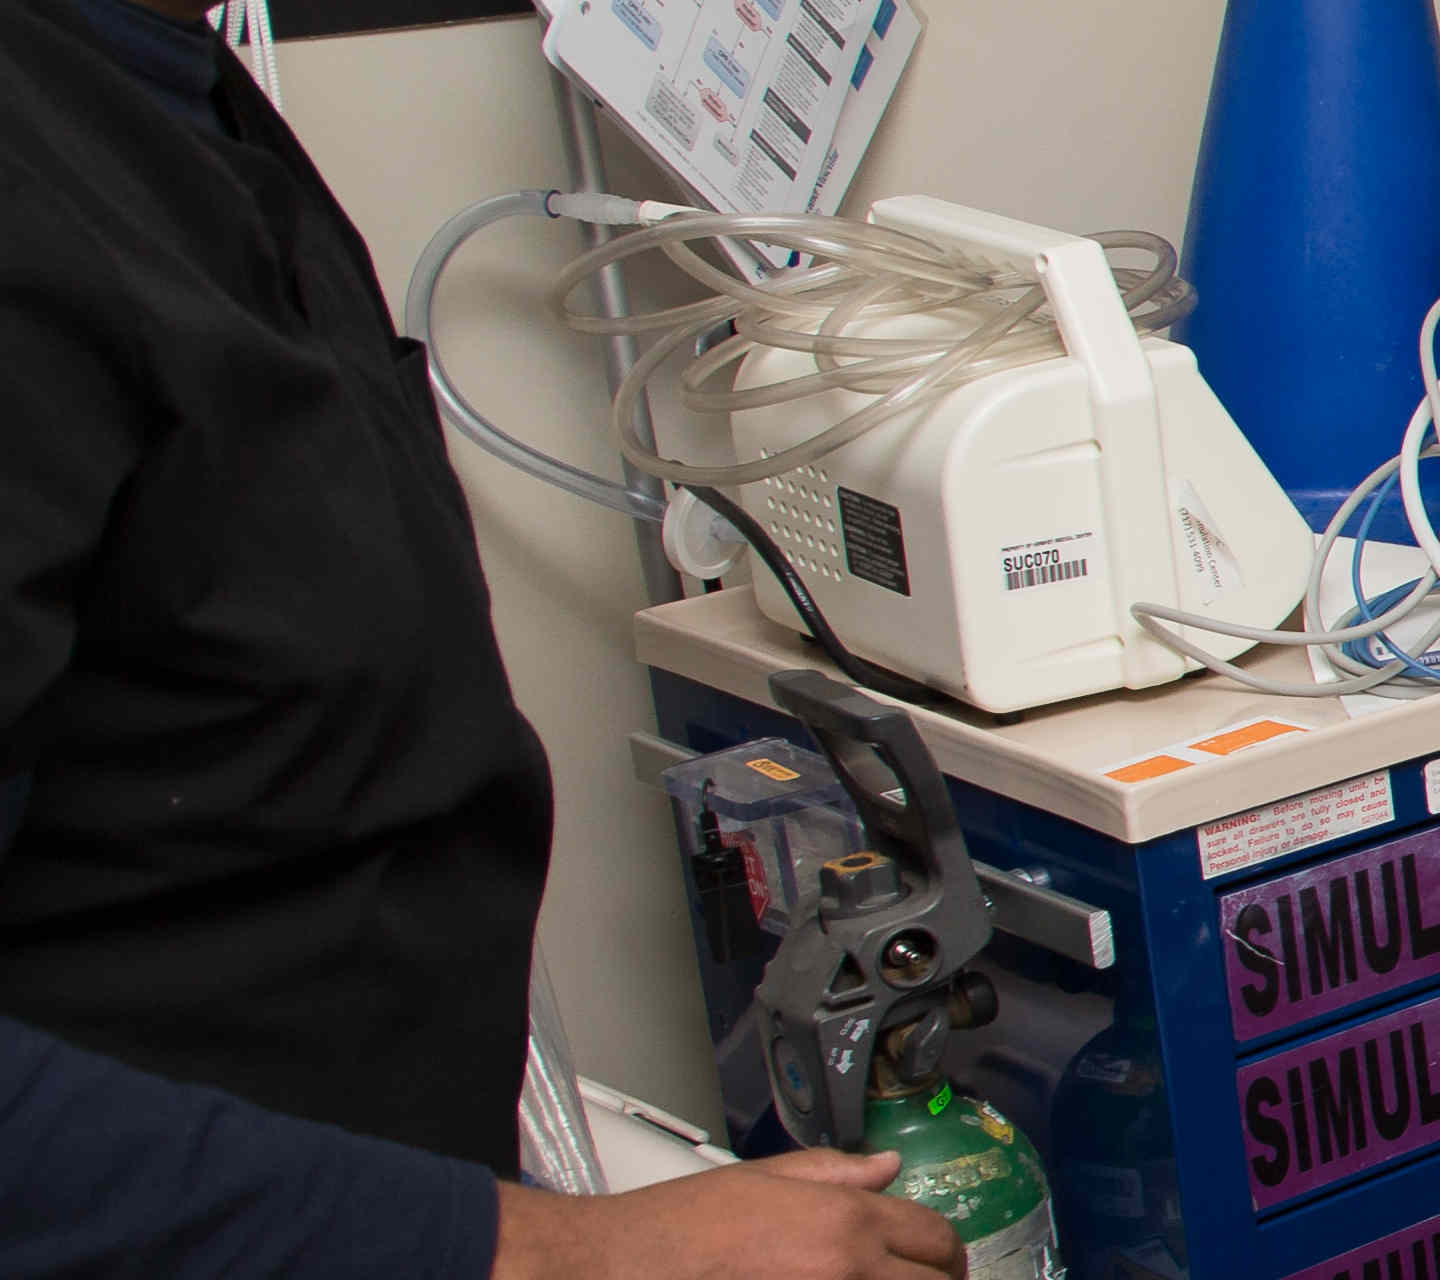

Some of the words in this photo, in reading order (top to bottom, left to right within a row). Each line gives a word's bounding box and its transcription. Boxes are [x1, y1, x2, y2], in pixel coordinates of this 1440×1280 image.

[1003, 548, 1061, 572] SUC070
[1204, 813, 1261, 836] WARNING:
[1274, 801, 1303, 816] Before
[1310, 789, 1343, 805] moving
[1208, 837, 1227, 848] sure
[1233, 830, 1243, 841] all
[1249, 819, 1285, 835] drawers
[1291, 812, 1305, 823] are
[1311, 804, 1330, 820] fully
[1336, 794, 1365, 809] closed
[1370, 787, 1386, 799] and
[1248, 832, 1280, 847] Failure
[1286, 827, 1295, 836] to
[1302, 821, 1312, 831] do
[1320, 817, 1331, 825] so
[1337, 810, 1354, 822] may
[1361, 799, 1388, 813] cause
[1209, 854, 1250, 873] Personal
[1252, 845, 1278, 859] injury
[1281, 840, 1290, 849] or
